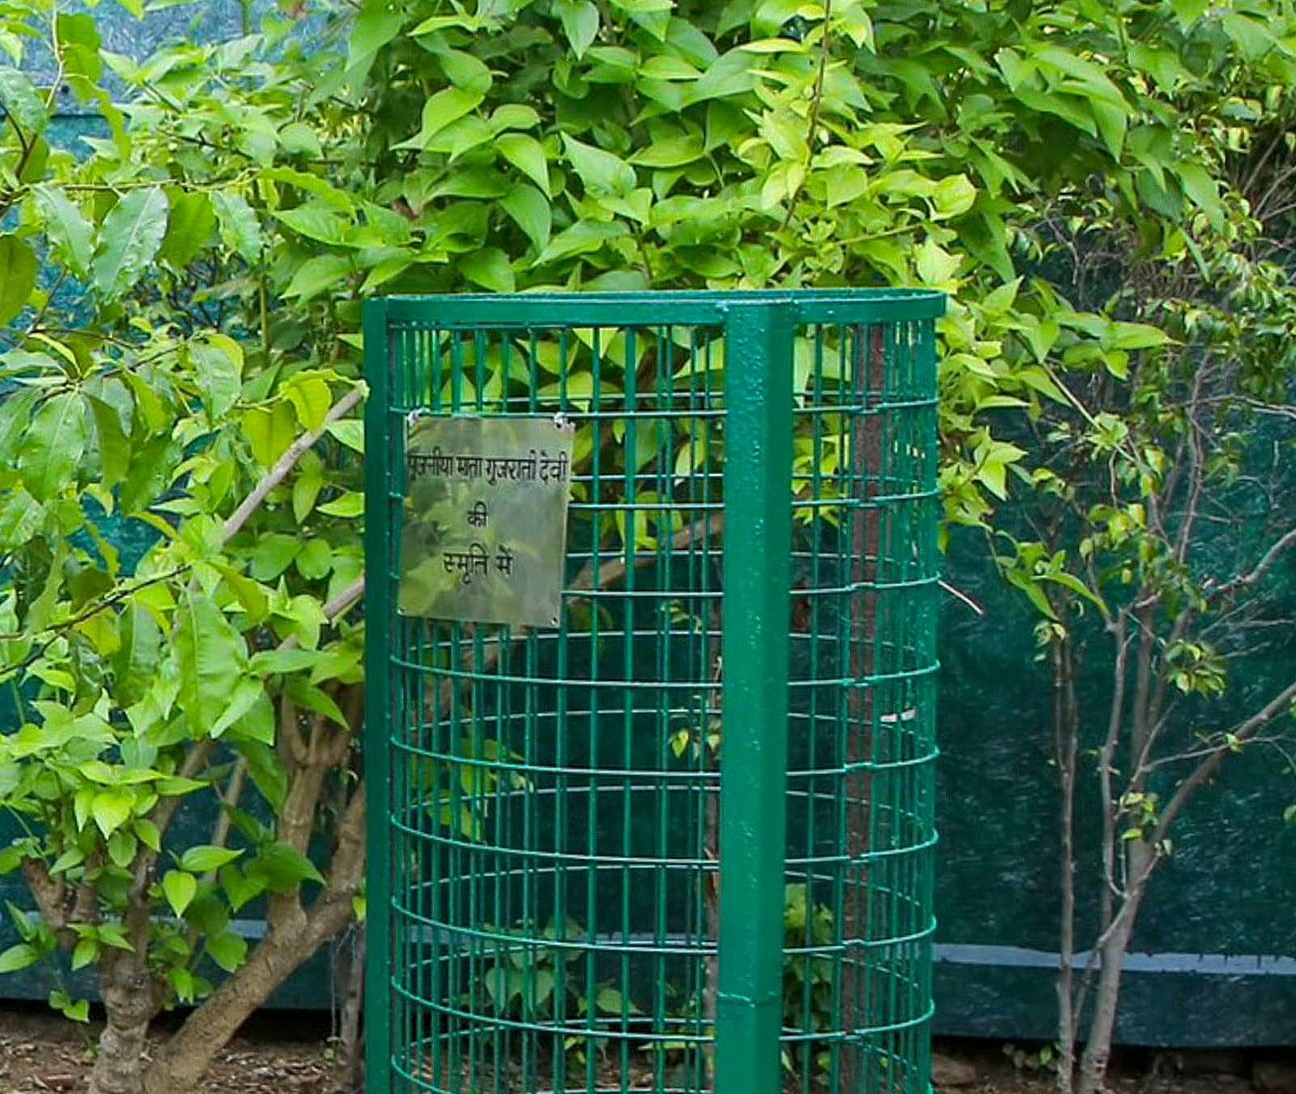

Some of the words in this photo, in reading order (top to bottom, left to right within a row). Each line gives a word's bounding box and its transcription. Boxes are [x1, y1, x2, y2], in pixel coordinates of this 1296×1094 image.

[456, 456, 483, 479] माता
[540, 450, 567, 484] देवी
[467, 501, 488, 528] की
[443, 543, 490, 584] स्मृति
[495, 545, 513, 575] में
